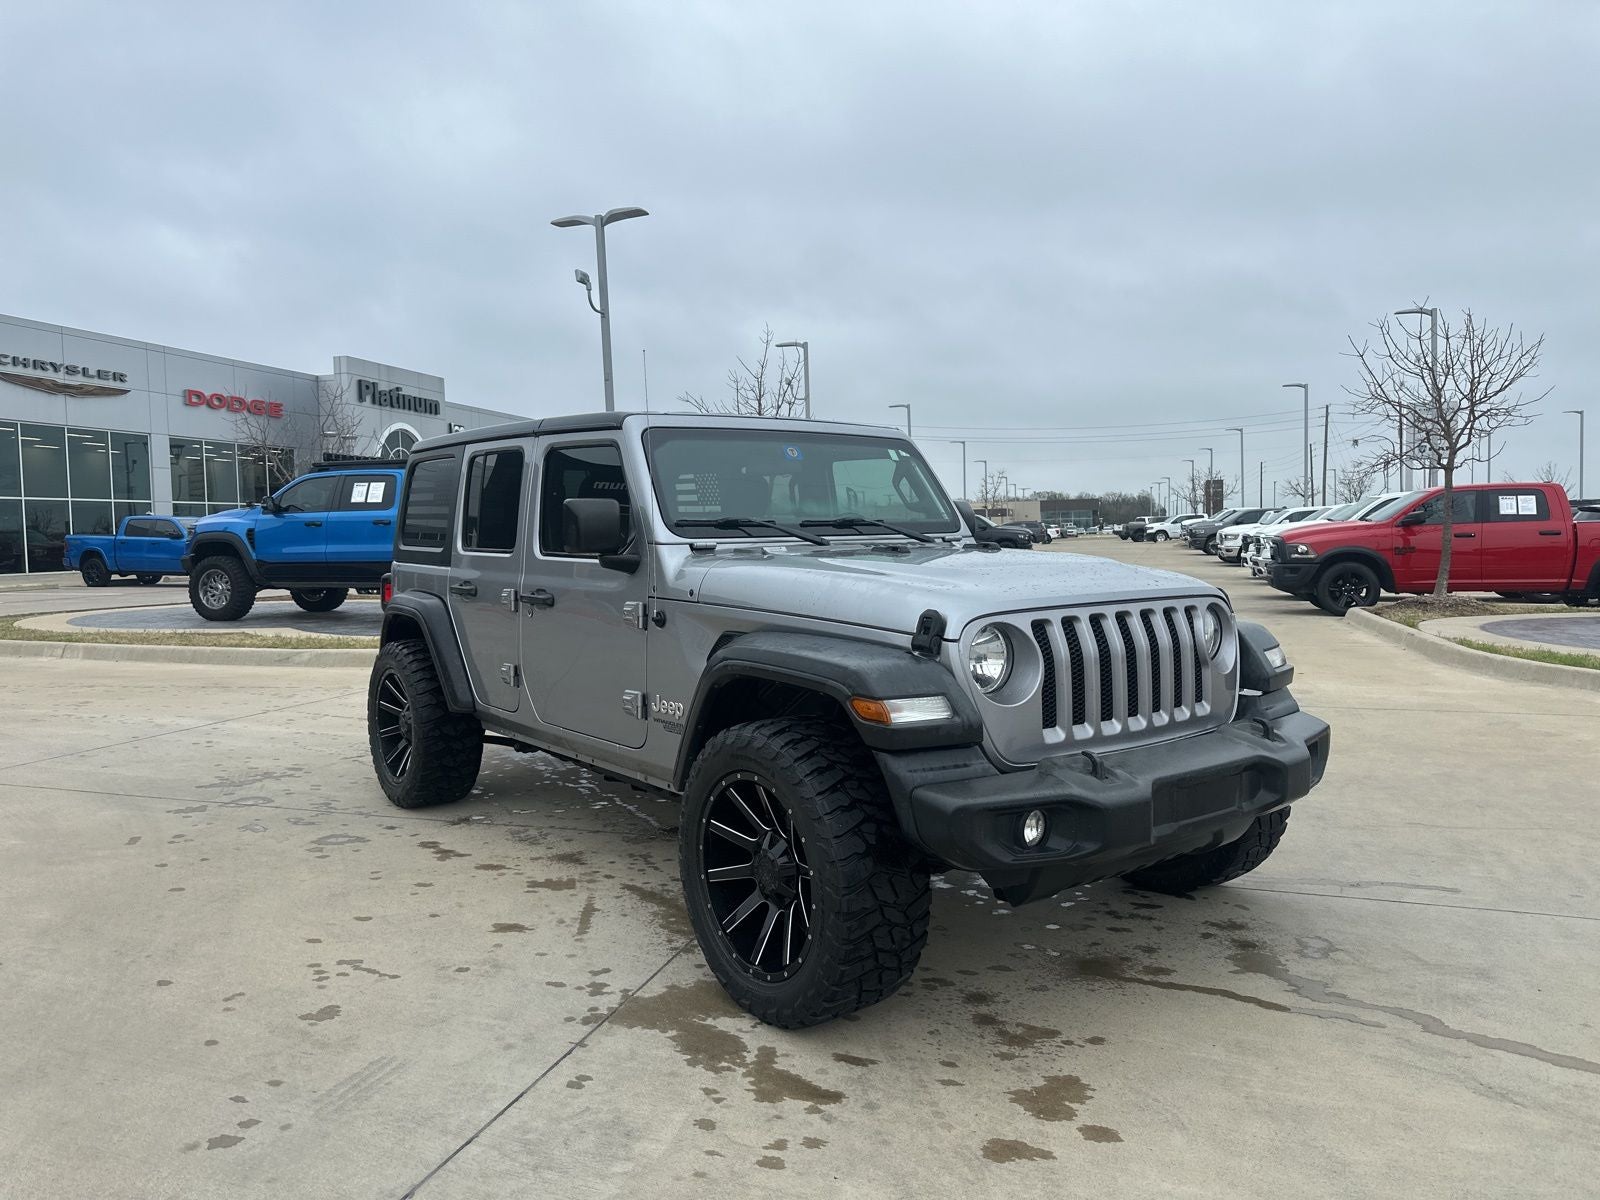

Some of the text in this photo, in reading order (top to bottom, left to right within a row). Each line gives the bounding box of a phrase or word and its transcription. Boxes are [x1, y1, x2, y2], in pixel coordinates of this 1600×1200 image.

[0, 354, 128, 383] CHRYSLER
[183, 389, 284, 418] DODGE
[358, 379, 440, 416] Platinum
[651, 694, 684, 720] Jeep
